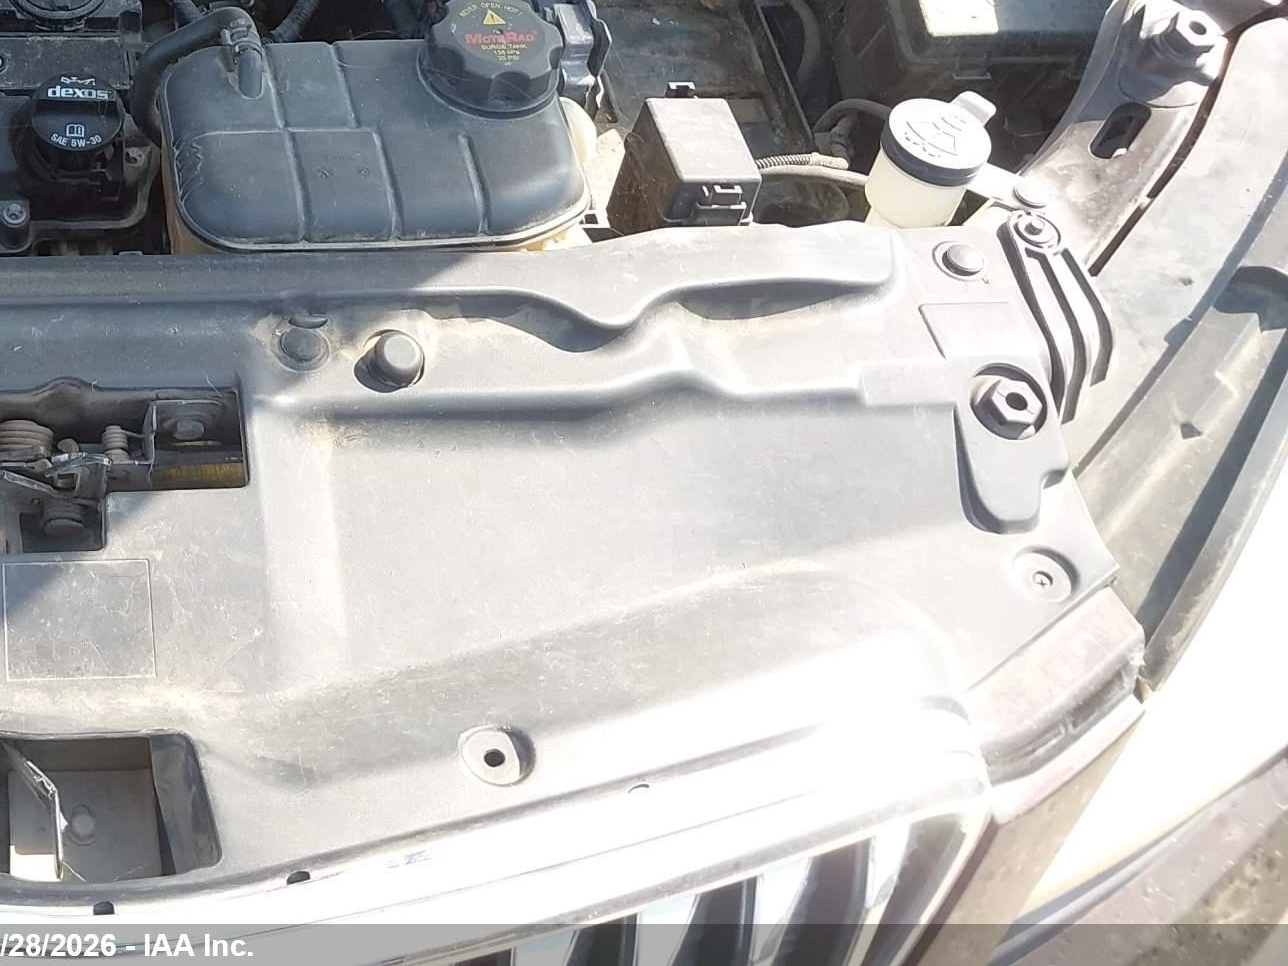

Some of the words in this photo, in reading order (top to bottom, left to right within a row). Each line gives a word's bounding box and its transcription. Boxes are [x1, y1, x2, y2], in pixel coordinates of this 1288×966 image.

[480, 2, 501, 10] OPEN
[48, 85, 109, 100] dexos
[51, 133, 68, 146] SAE
[71, 134, 102, 147] 5W-30
